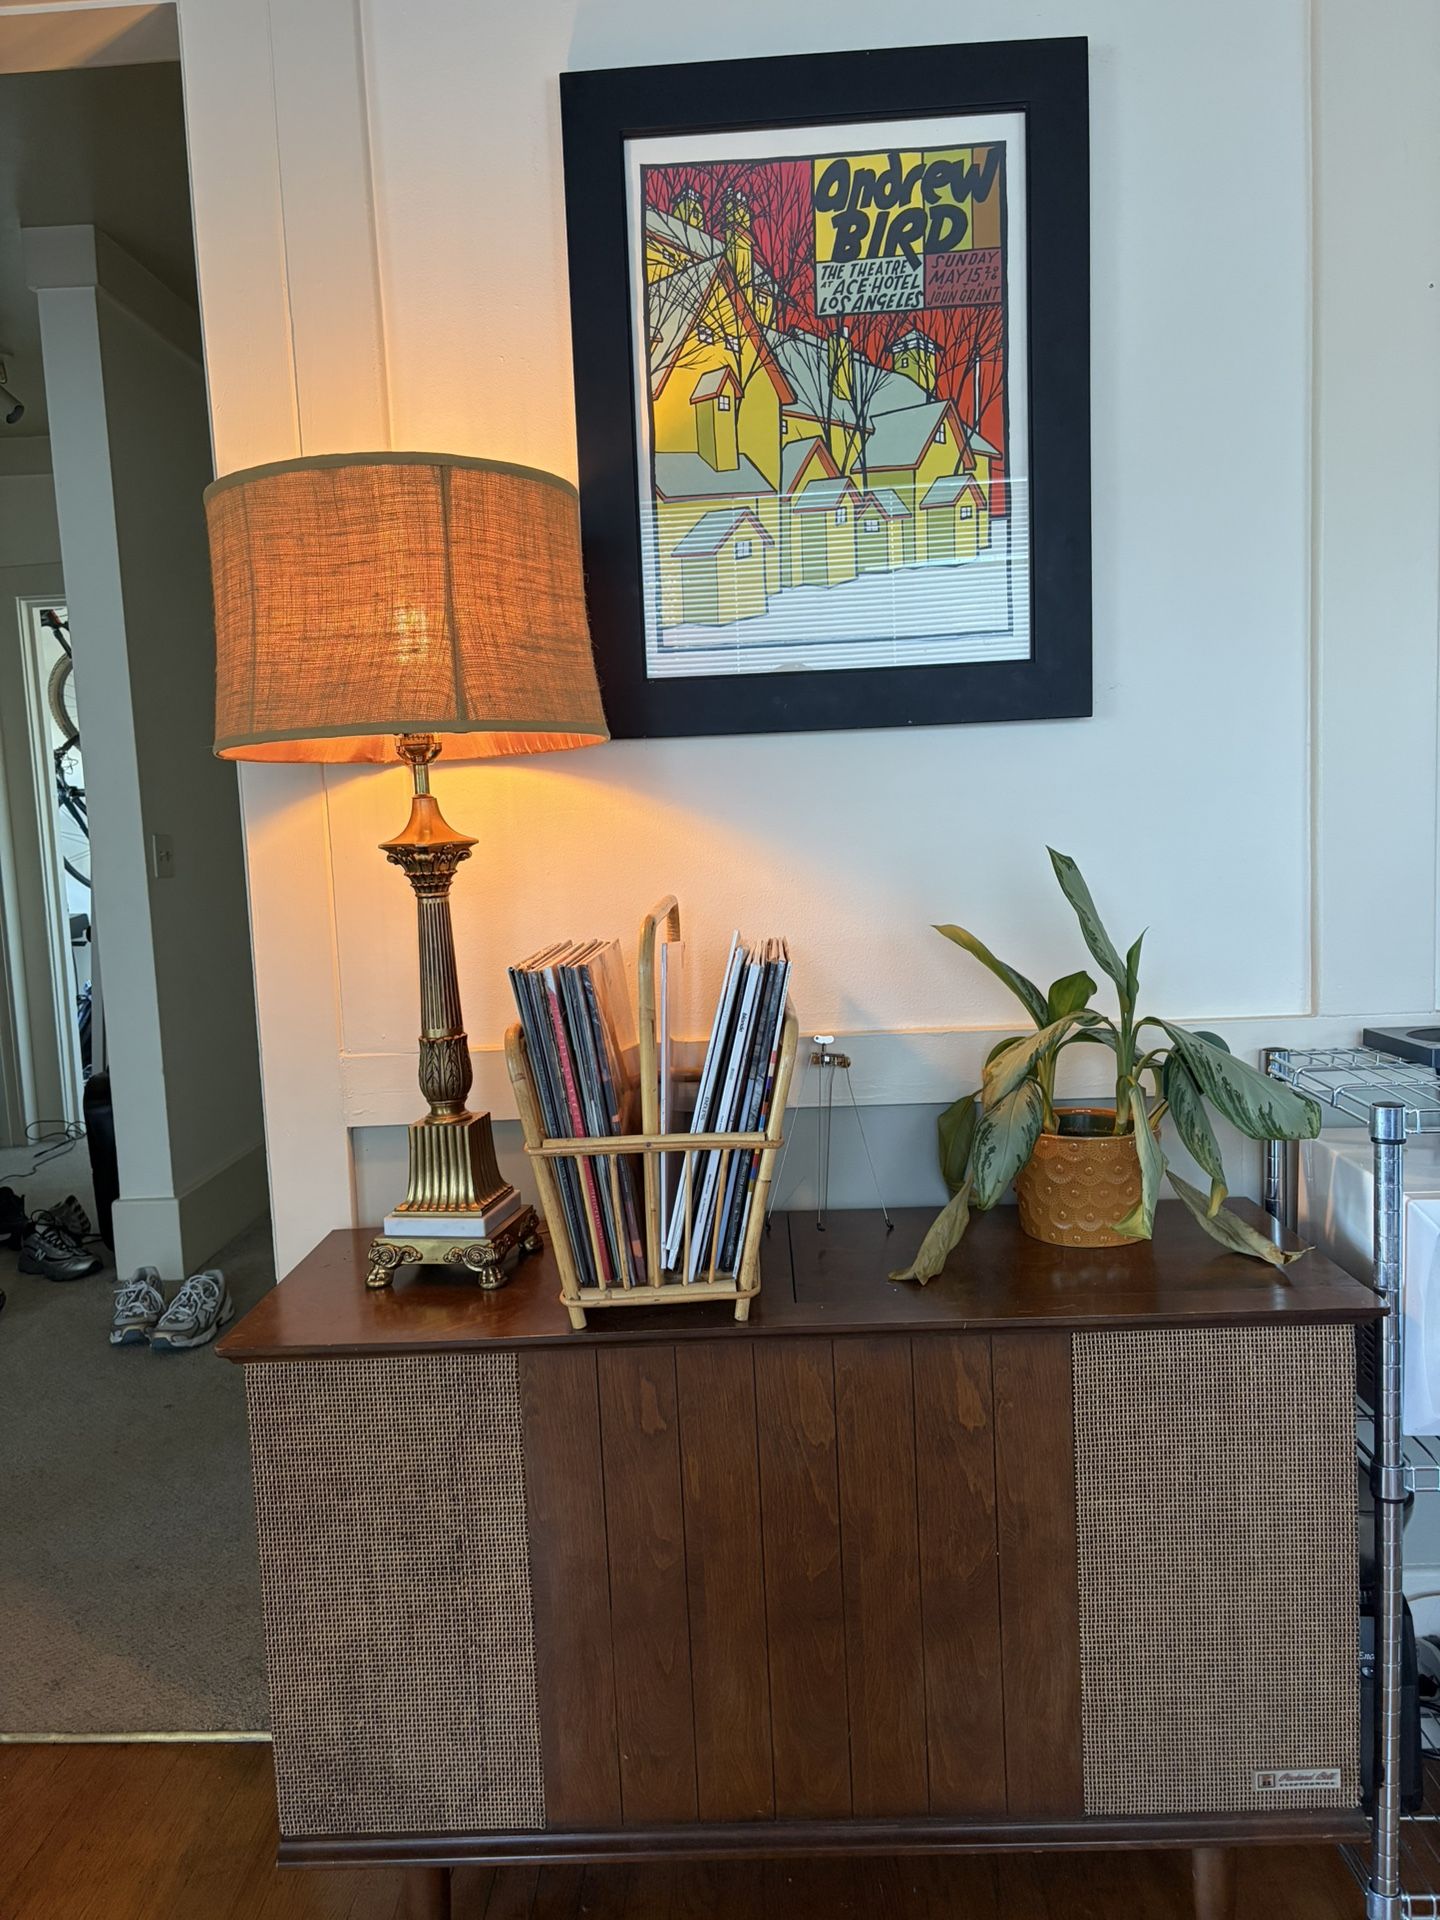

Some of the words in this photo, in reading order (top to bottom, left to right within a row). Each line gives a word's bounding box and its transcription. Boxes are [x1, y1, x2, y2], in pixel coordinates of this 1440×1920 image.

[831, 204, 969, 272] BIRD
[821, 264, 845, 280] THE
[849, 260, 909, 278] THEATRE
[931, 251, 999, 269] SUNDAY
[928, 268, 967, 286] MAY
[967, 268, 983, 282] 15
[819, 295, 852, 314] LOS
[851, 290, 924, 313] ANGELES
[927, 289, 959, 306] JOHN
[960, 286, 1001, 302] GRANT
